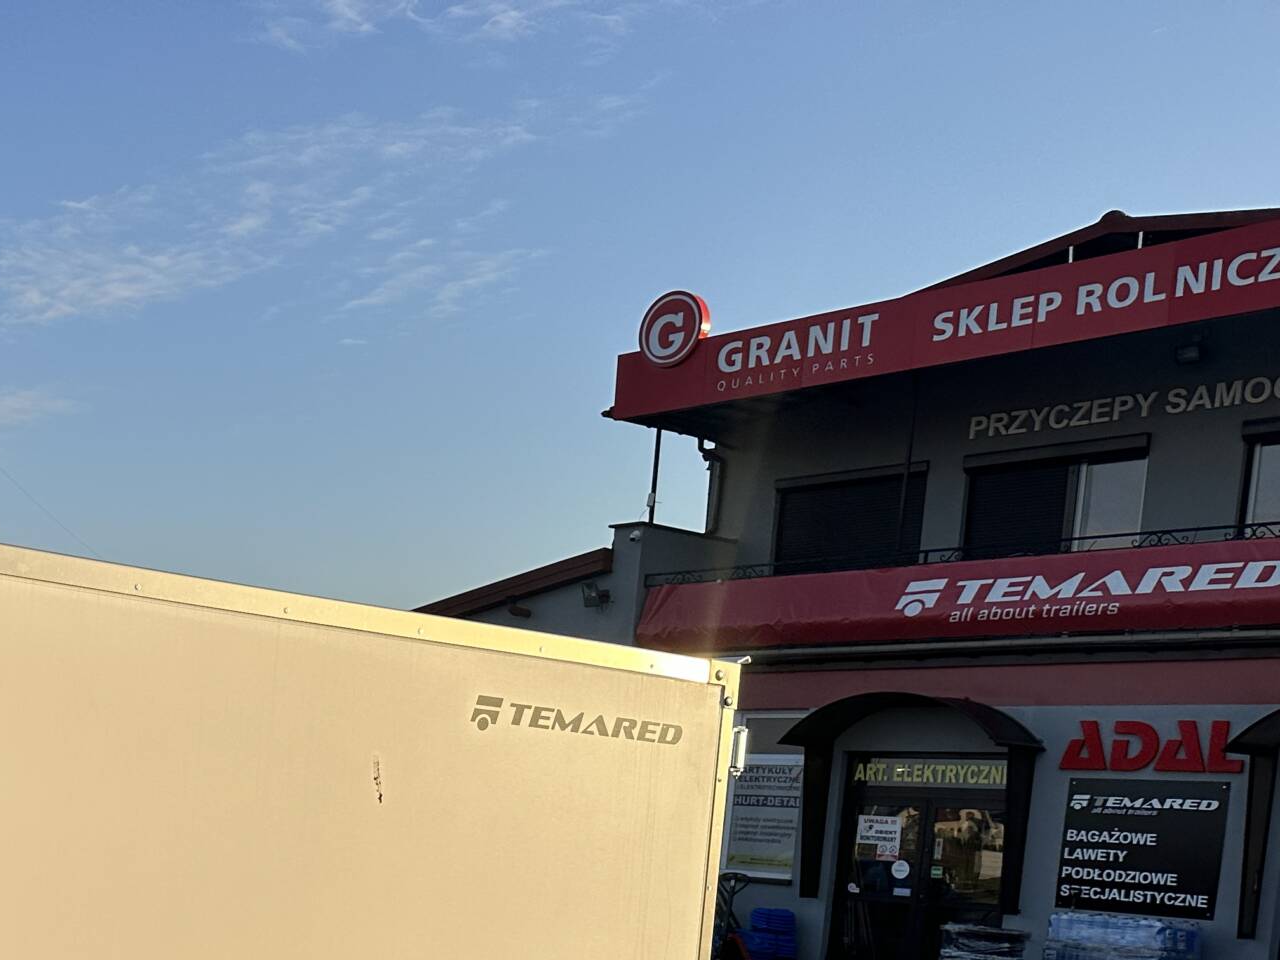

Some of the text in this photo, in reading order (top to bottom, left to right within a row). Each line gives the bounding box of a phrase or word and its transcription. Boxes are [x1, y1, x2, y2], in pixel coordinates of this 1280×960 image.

[648, 312, 685, 357] G
[932, 291, 1063, 341] SKLEP
[717, 313, 880, 374] GRANIT
[716, 353, 875, 392] QUALITY PARTS
[969, 376, 1280, 440] PRZYCZEPY SAMO
[955, 560, 1280, 605] TEMARED
[949, 601, 1120, 623] all about trailers
[509, 702, 684, 745] TEMARED
[1059, 719, 1245, 773] ADAL
[854, 763, 888, 781] ART.
[1092, 796, 1220, 811] TEMARED
[1063, 848, 1128, 862] LAWETY
[1066, 828, 1158, 846] BAGAŻOWE
[1061, 867, 1178, 886] PODŁODZIOWE
